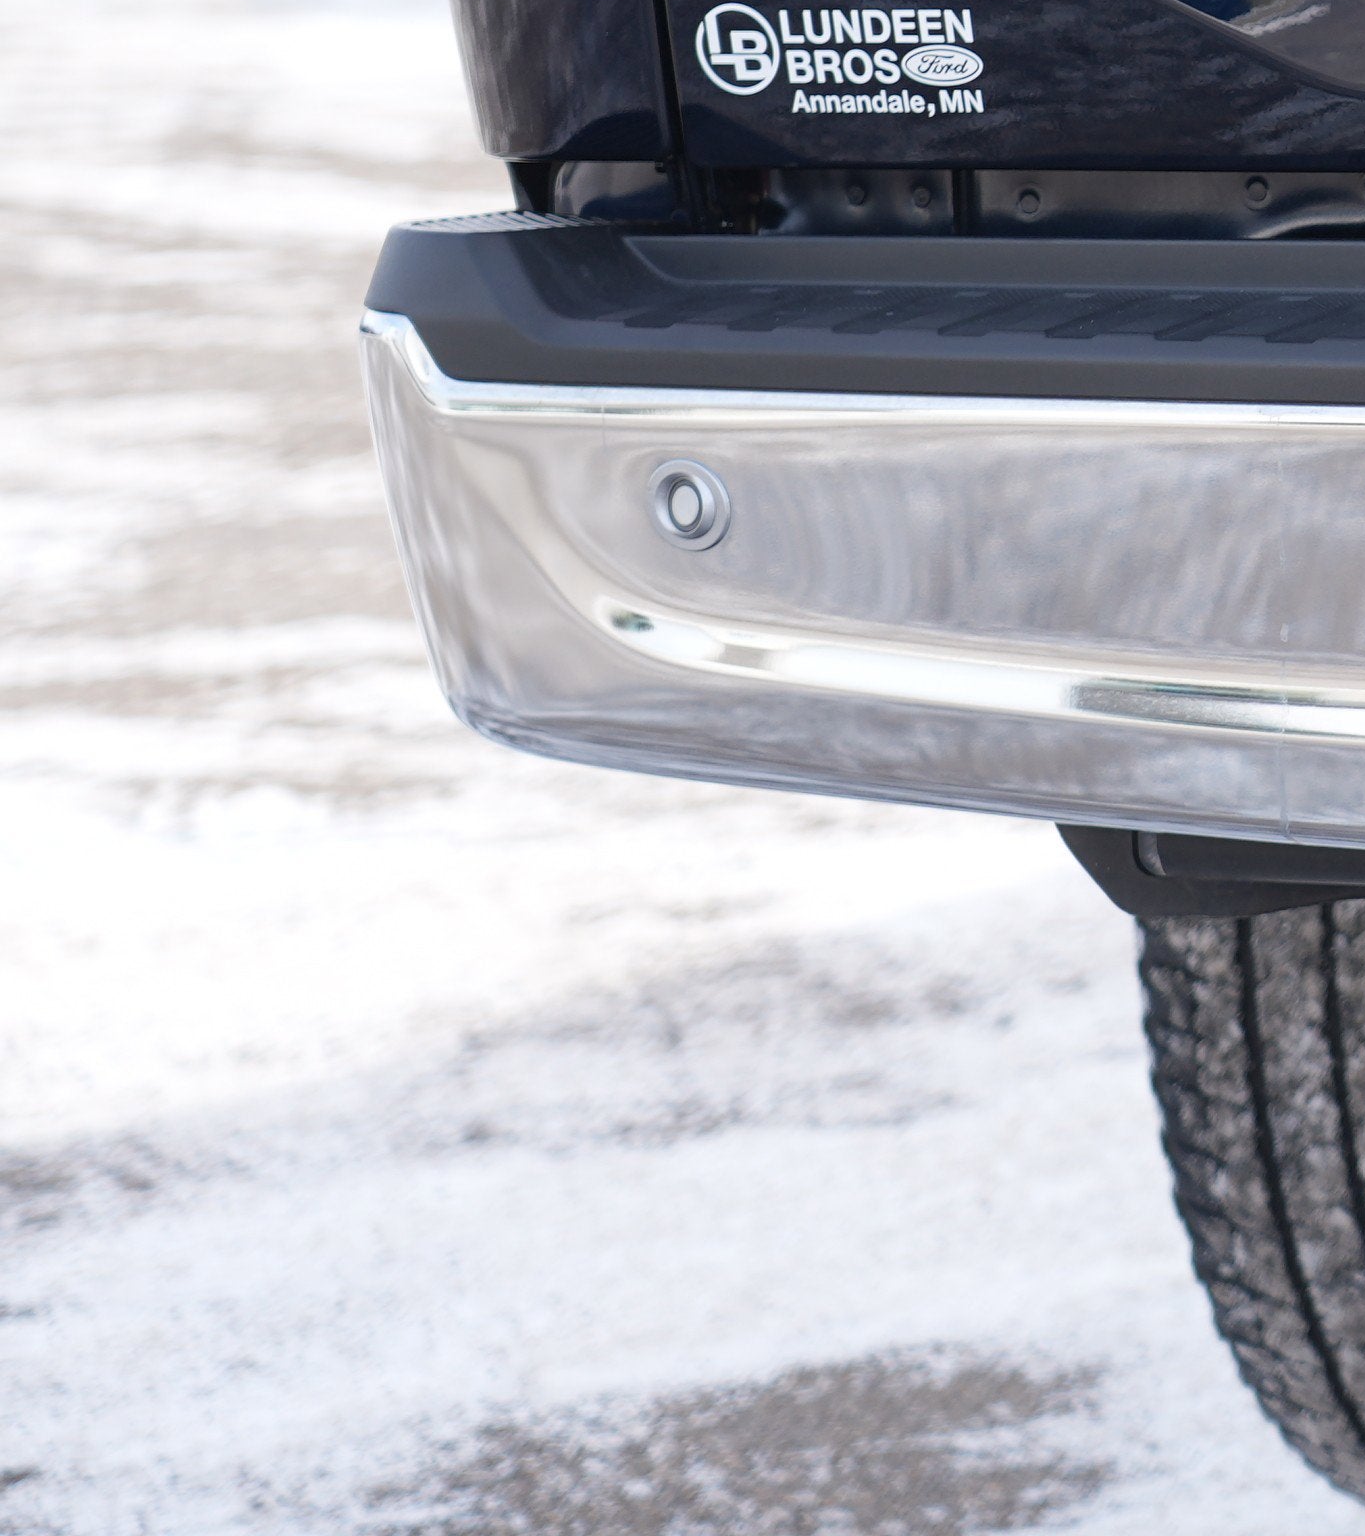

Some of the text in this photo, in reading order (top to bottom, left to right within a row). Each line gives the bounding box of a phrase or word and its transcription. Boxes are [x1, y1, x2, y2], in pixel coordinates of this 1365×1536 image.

[778, 9, 974, 44] LUNDEEN
[785, 49, 901, 84] BROS
[917, 55, 968, 75] Ford
[792, 90, 984, 117] Annandale, MN
